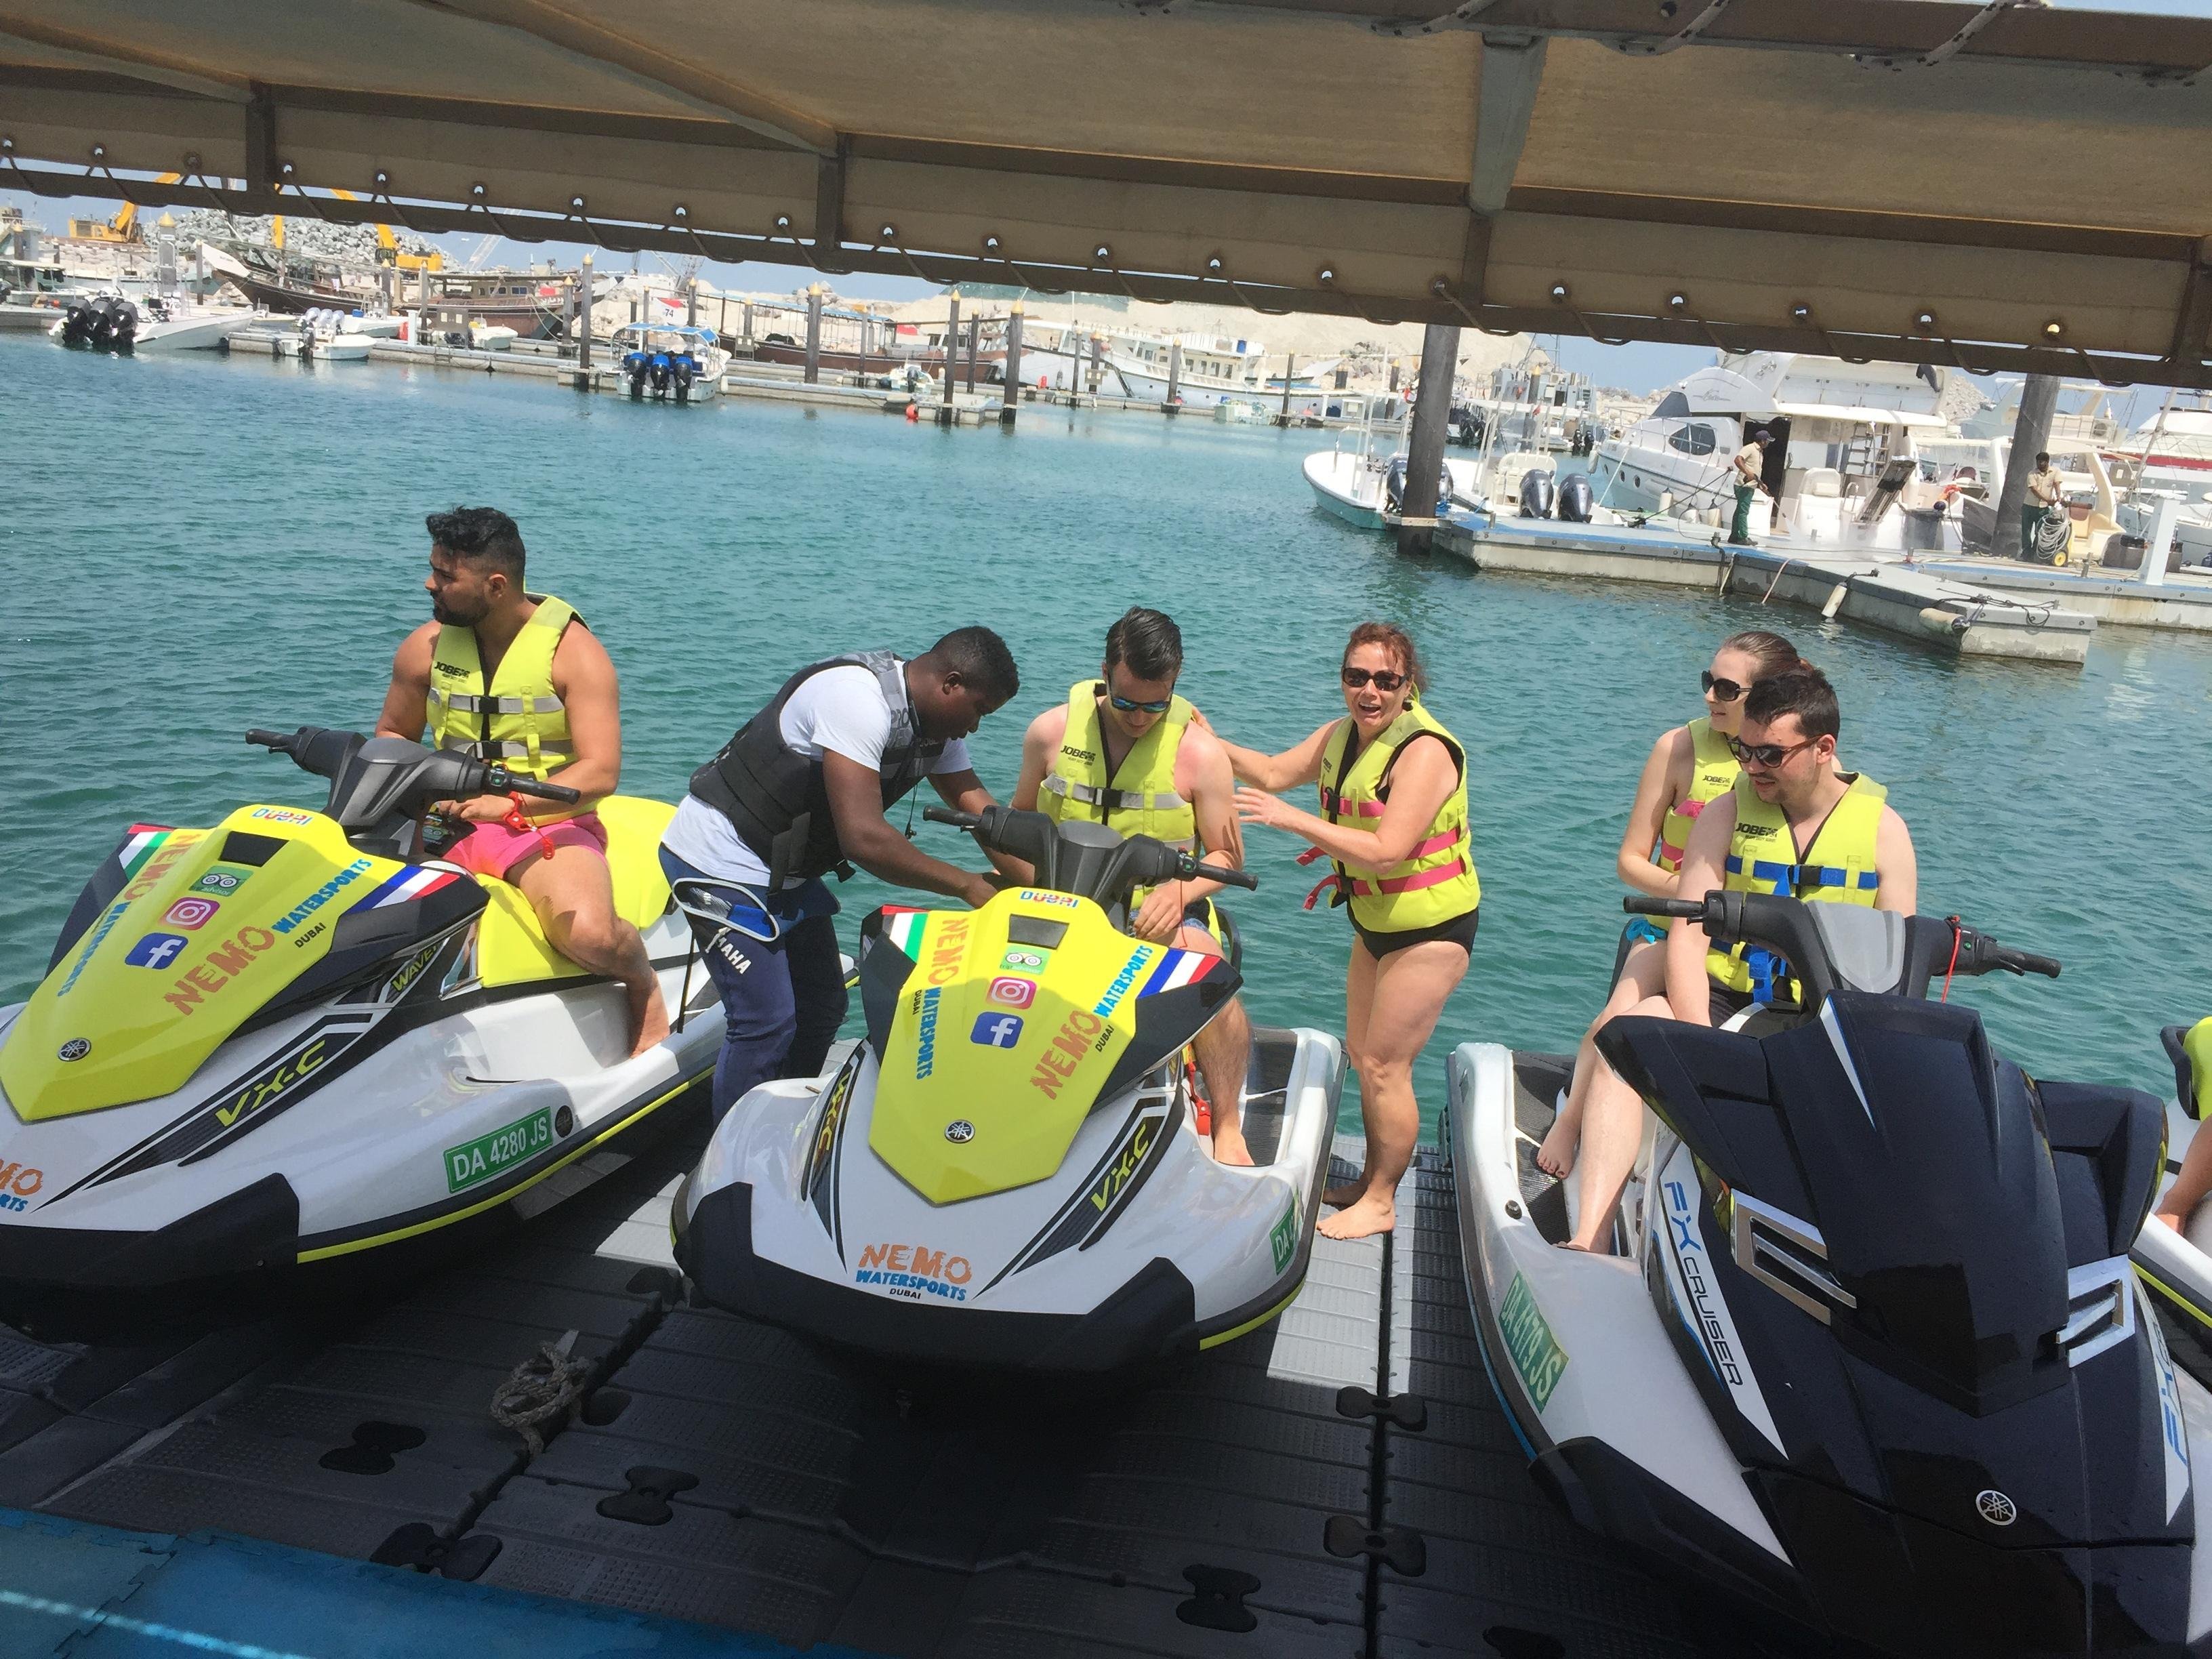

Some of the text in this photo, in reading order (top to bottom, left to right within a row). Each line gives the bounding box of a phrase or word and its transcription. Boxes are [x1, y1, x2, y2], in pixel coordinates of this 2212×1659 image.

[1061, 745, 1087, 759] JOBE
[1735, 823, 1767, 836] JOBE
[163, 859, 372, 1015] NEMO WATERSPORTS
[294, 922, 326, 948] DUBAI
[912, 989, 922, 1015] DUBAI
[916, 918, 969, 1080] NEMO WATERSPORTS
[1030, 945, 1153, 1100] NEMO WATERSPORTS
[1094, 1025, 1114, 1052] DUBAI
[453, 1117, 548, 1181] DA 4280 JS
[858, 1244, 972, 1284] NEMO
[855, 1270, 966, 1301] WATERSPORTS
[889, 1288, 921, 1299] DUBAI
[1664, 1181, 1744, 1386] FX CRUISER
[1501, 1276, 1524, 1334] DA
[1530, 1345, 1562, 1401] JS
